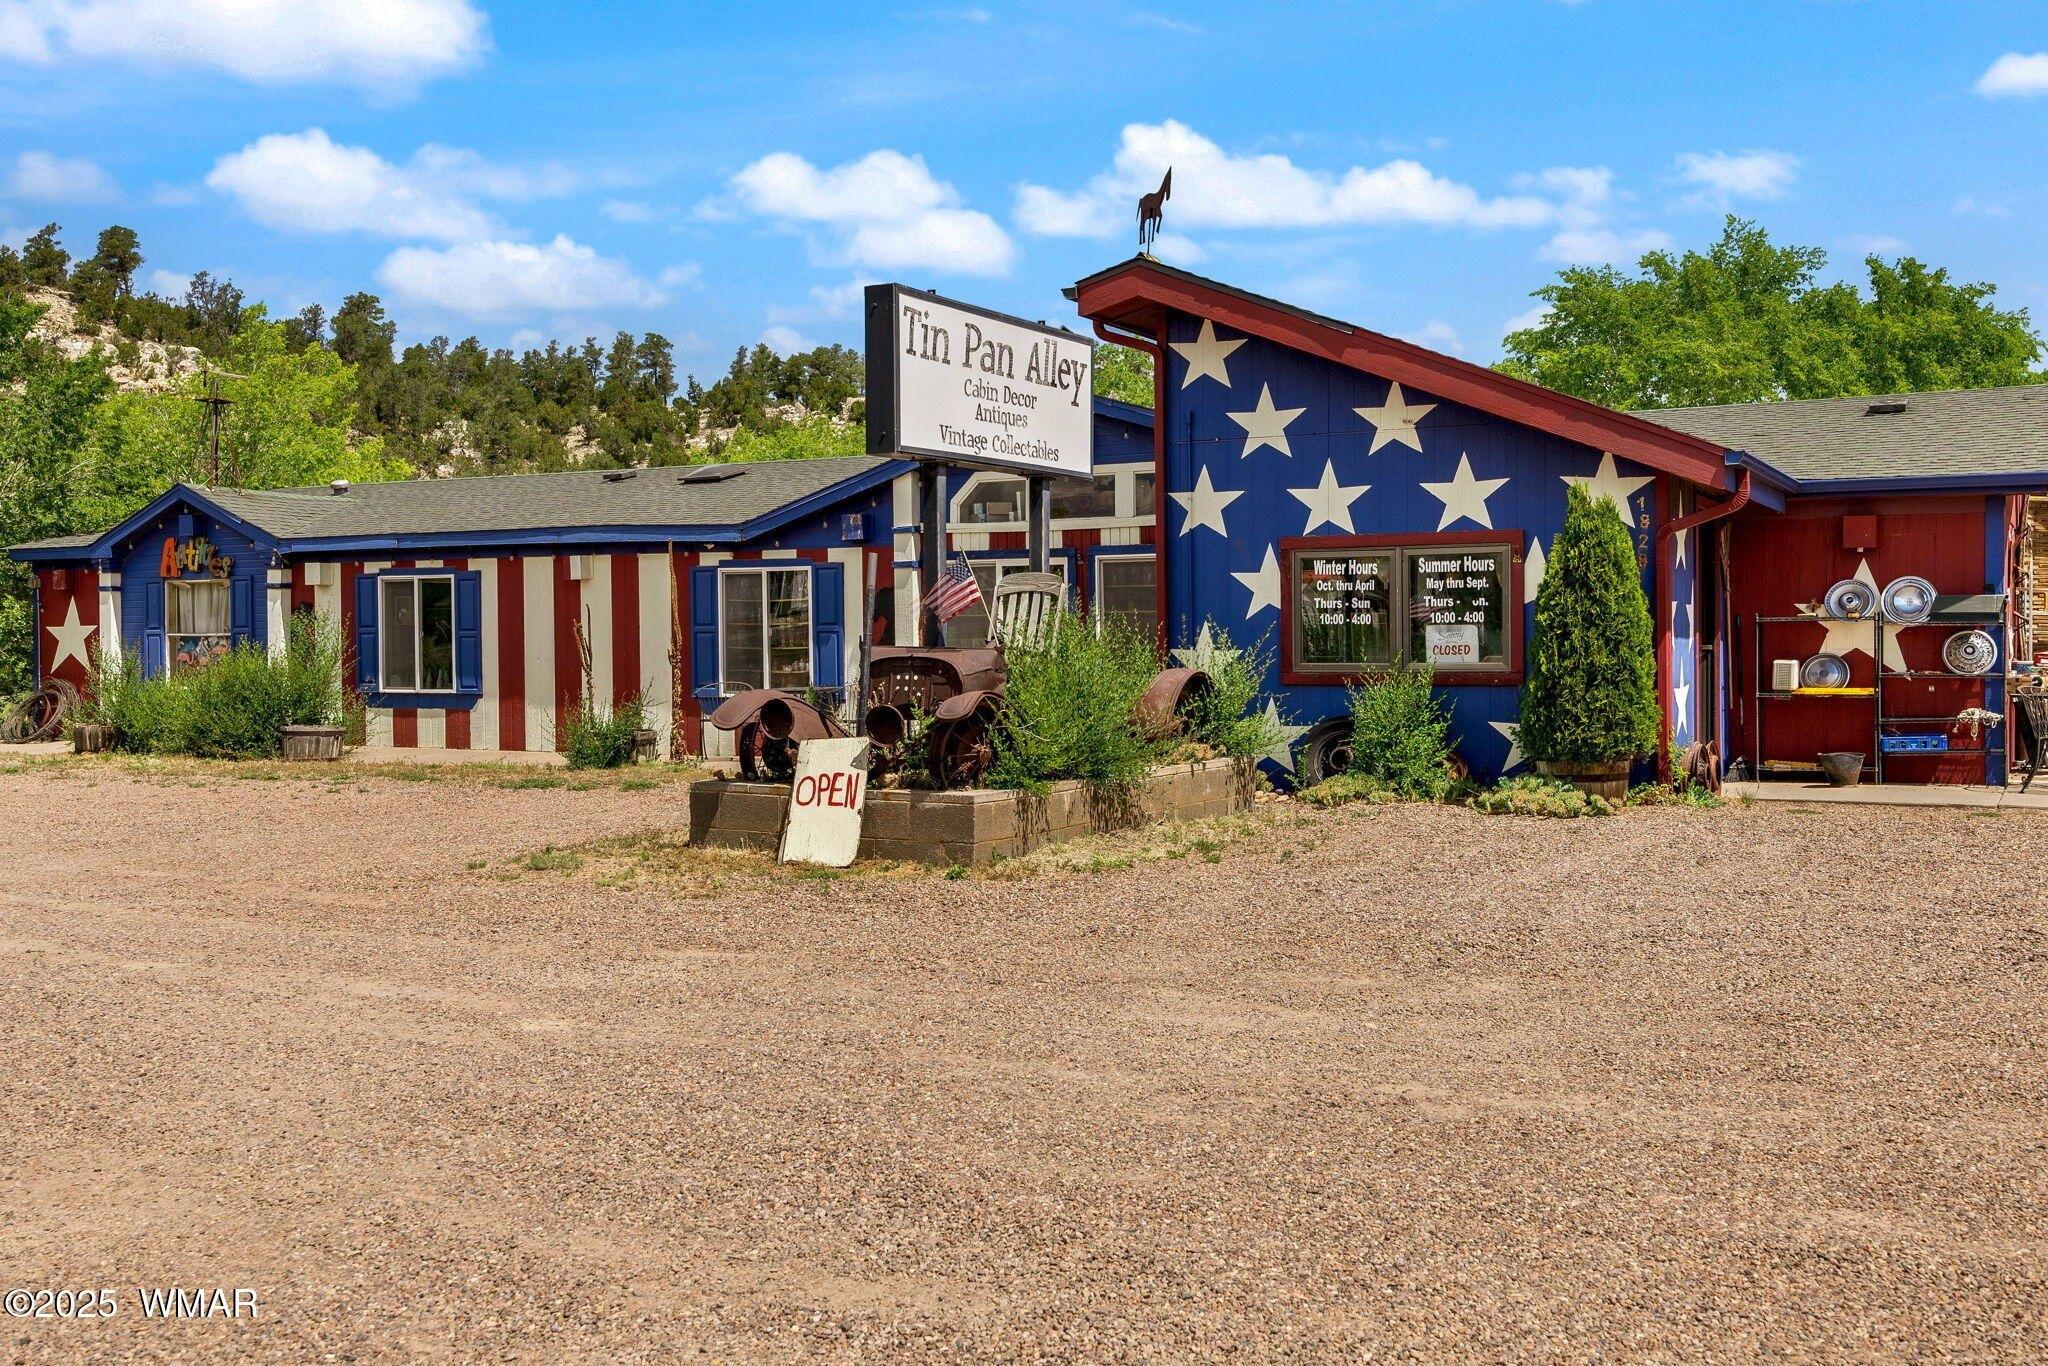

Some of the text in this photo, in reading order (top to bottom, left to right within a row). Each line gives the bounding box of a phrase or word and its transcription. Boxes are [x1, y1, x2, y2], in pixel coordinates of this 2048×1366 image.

[903, 305, 1087, 407] Tin Pan Alley
[964, 378, 1037, 410] Cabin Decor
[975, 403, 1028, 431] Antiques
[939, 424, 1059, 462] Vintage Collectables
[1313, 559, 1378, 575] Winter Hours
[1418, 556, 1495, 573] Summer Hours
[1316, 580, 1375, 593] Oct. thru April
[1426, 576, 1489, 591] May thru Sept.
[1313, 597, 1342, 609] Thurs
[1351, 597, 1371, 609] Sun
[1424, 596, 1454, 607] Thurs
[1319, 613, 1344, 625] 10:00
[1351, 613, 1372, 625] 4:00
[1429, 612, 1455, 624] 10:00
[1463, 611, 1485, 623] 4:00
[1432, 644, 1471, 656] CLOSED
[795, 772, 860, 810] OPEN
